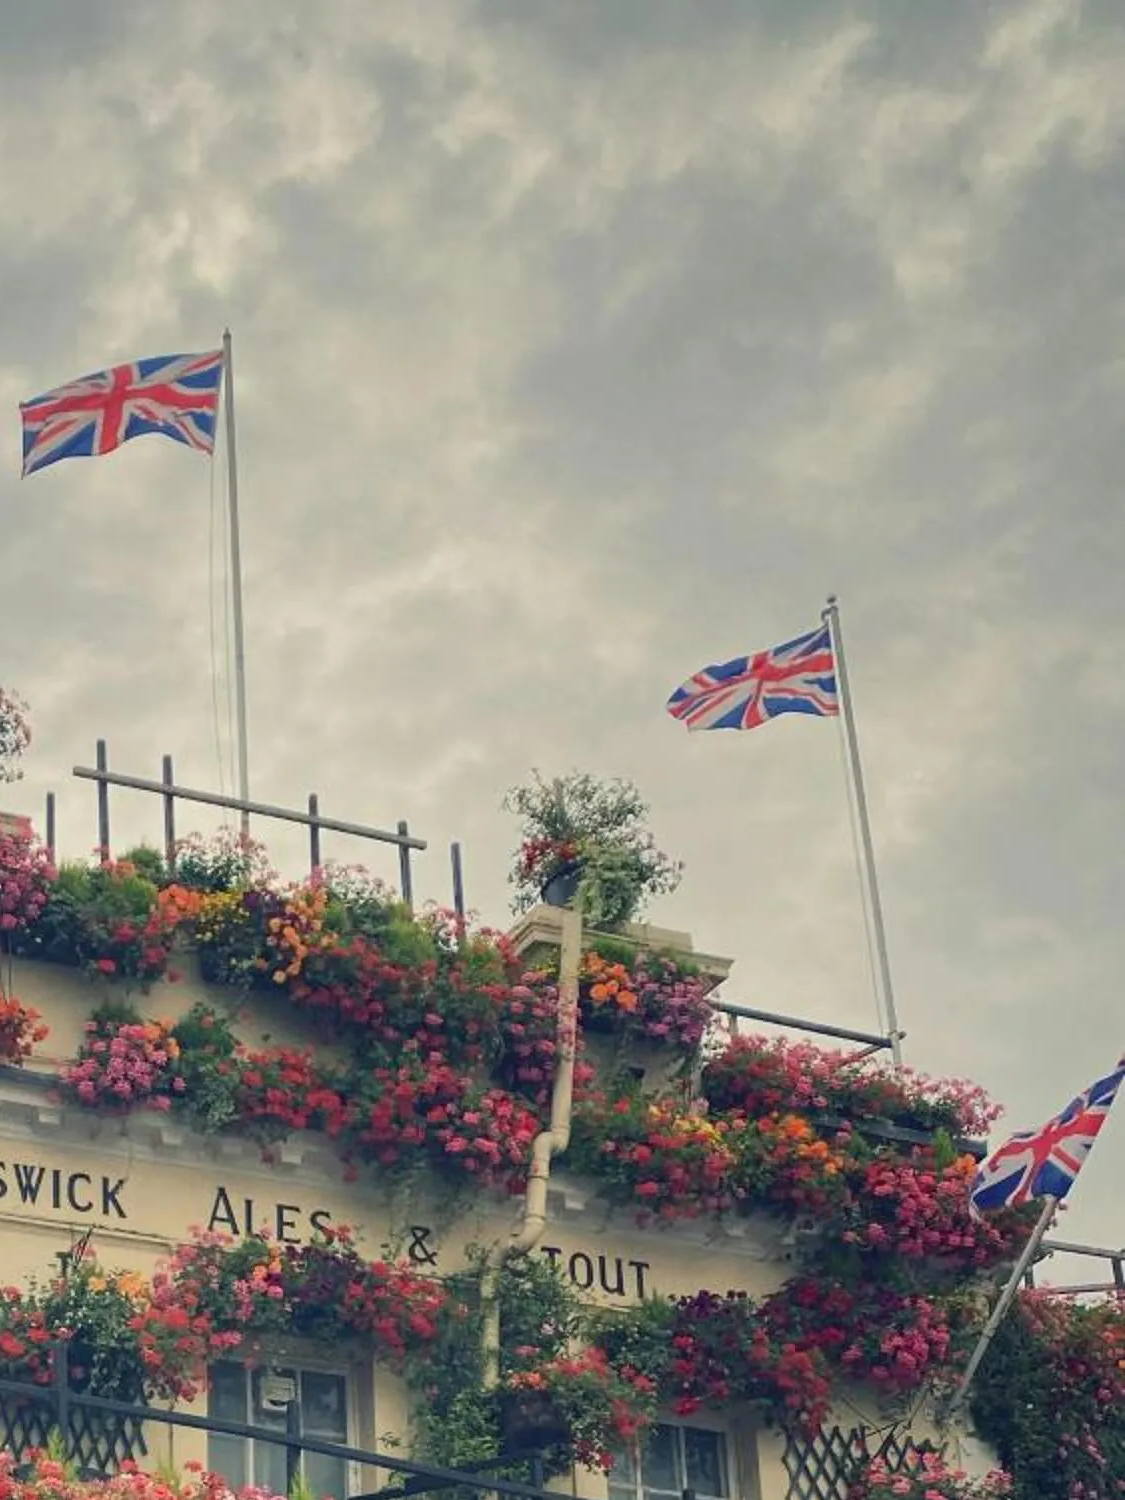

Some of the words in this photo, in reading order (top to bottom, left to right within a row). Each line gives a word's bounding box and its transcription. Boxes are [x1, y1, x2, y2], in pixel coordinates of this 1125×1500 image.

[208, 1186, 334, 1245] ALES
[408, 1225, 438, 1267] &
[540, 1245, 650, 1299] TOUT
